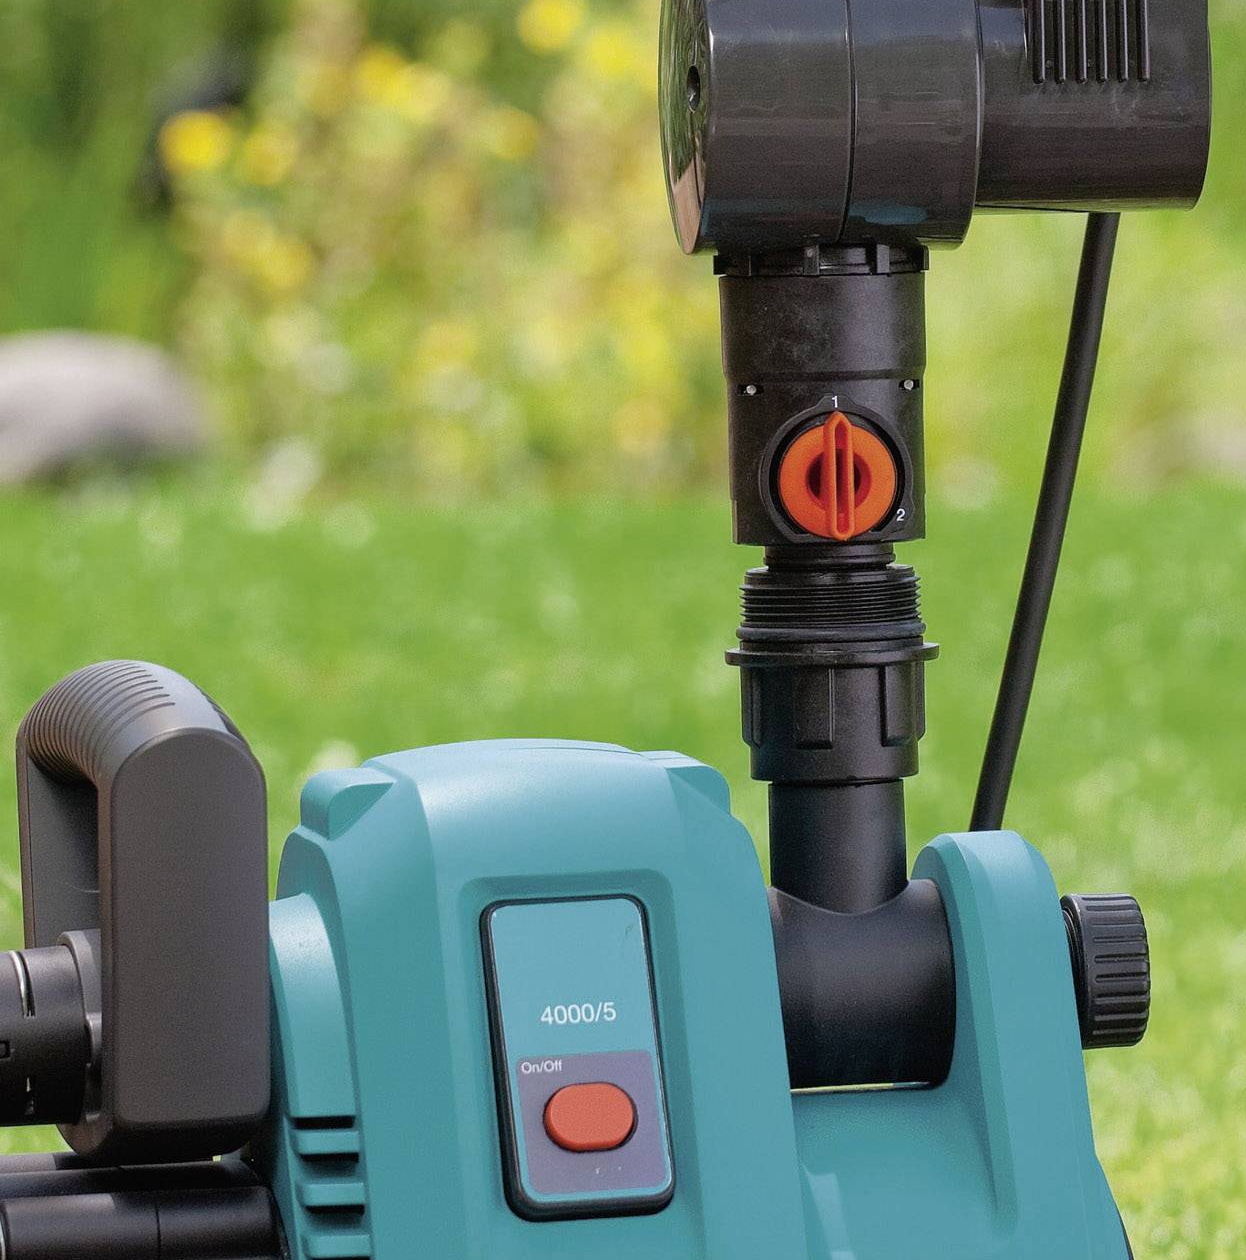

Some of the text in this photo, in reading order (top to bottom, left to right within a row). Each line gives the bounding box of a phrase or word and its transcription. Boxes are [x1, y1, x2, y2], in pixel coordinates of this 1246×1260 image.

[832, 396, 838, 408] 1
[896, 509, 906, 522] 2
[540, 1002, 617, 1025] 4000/5
[521, 1059, 563, 1074] On/Off
